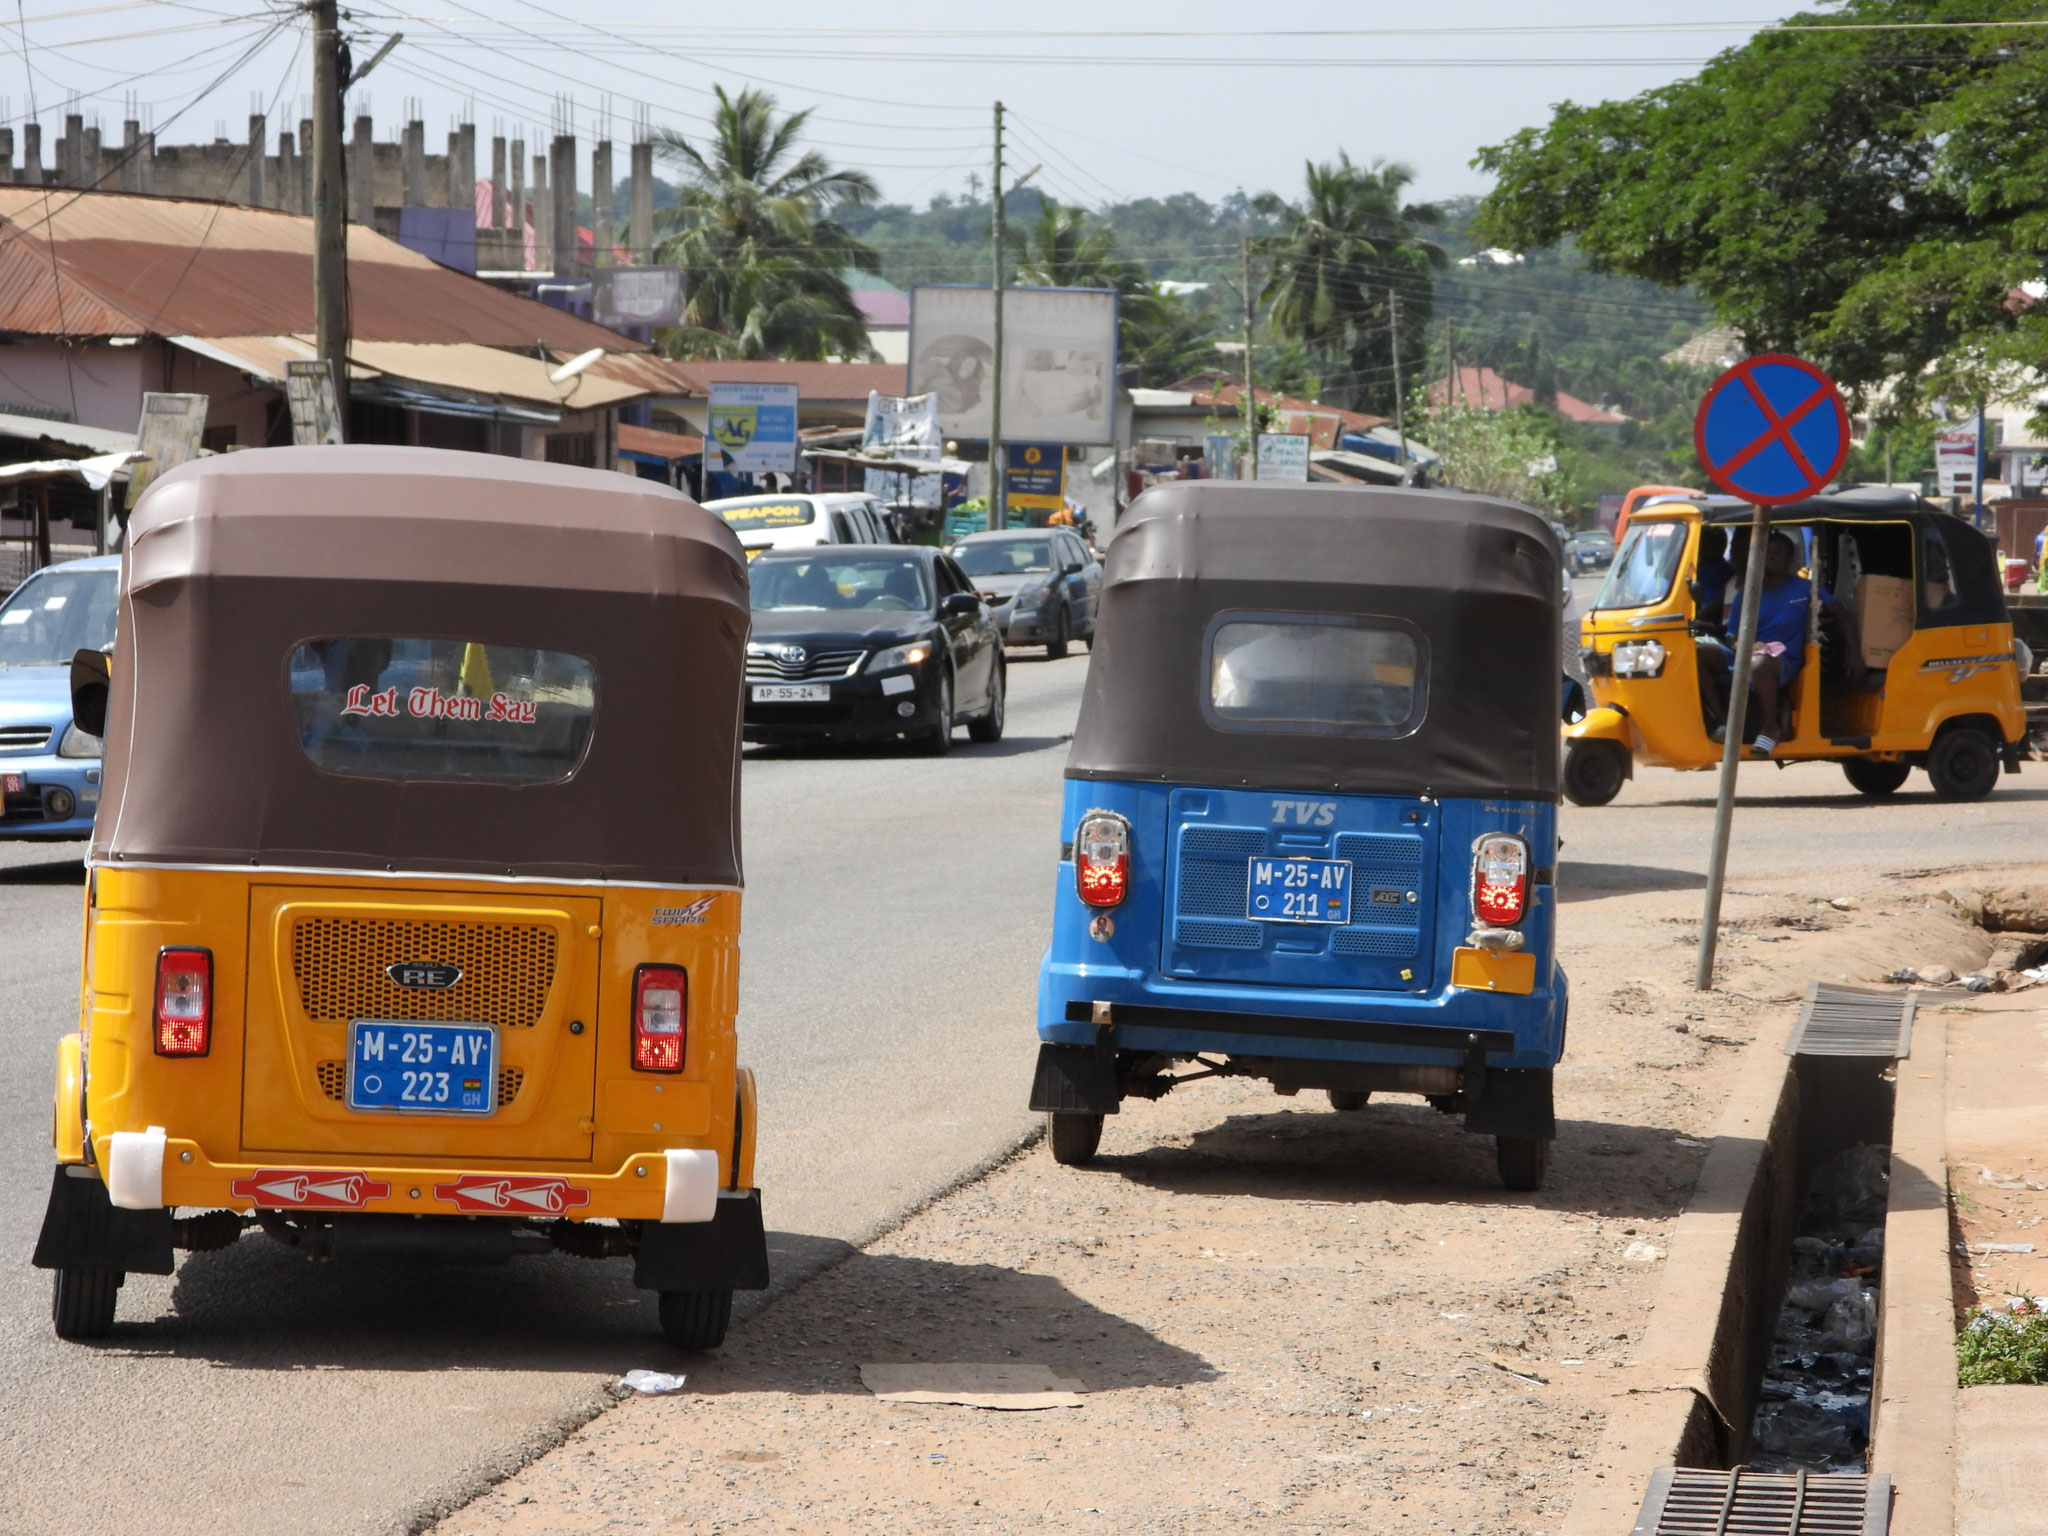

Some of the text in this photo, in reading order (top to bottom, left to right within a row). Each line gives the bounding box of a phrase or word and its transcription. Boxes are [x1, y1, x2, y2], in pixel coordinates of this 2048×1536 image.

[722, 505, 801, 521] WEAPON
[340, 683, 537, 723] Let Them Say
[1271, 799, 1337, 826] TVS
[1256, 862, 1345, 889] M-25-AY
[652, 906, 694, 917] TWIN
[1283, 893, 1319, 917] 211
[1327, 909, 1341, 920] GH
[651, 915, 708, 925] SPARK
[403, 969, 446, 985] RE
[363, 1031, 483, 1066] M-25-AY
[401, 1071, 450, 1103] 223
[462, 1092, 481, 1106] GH
